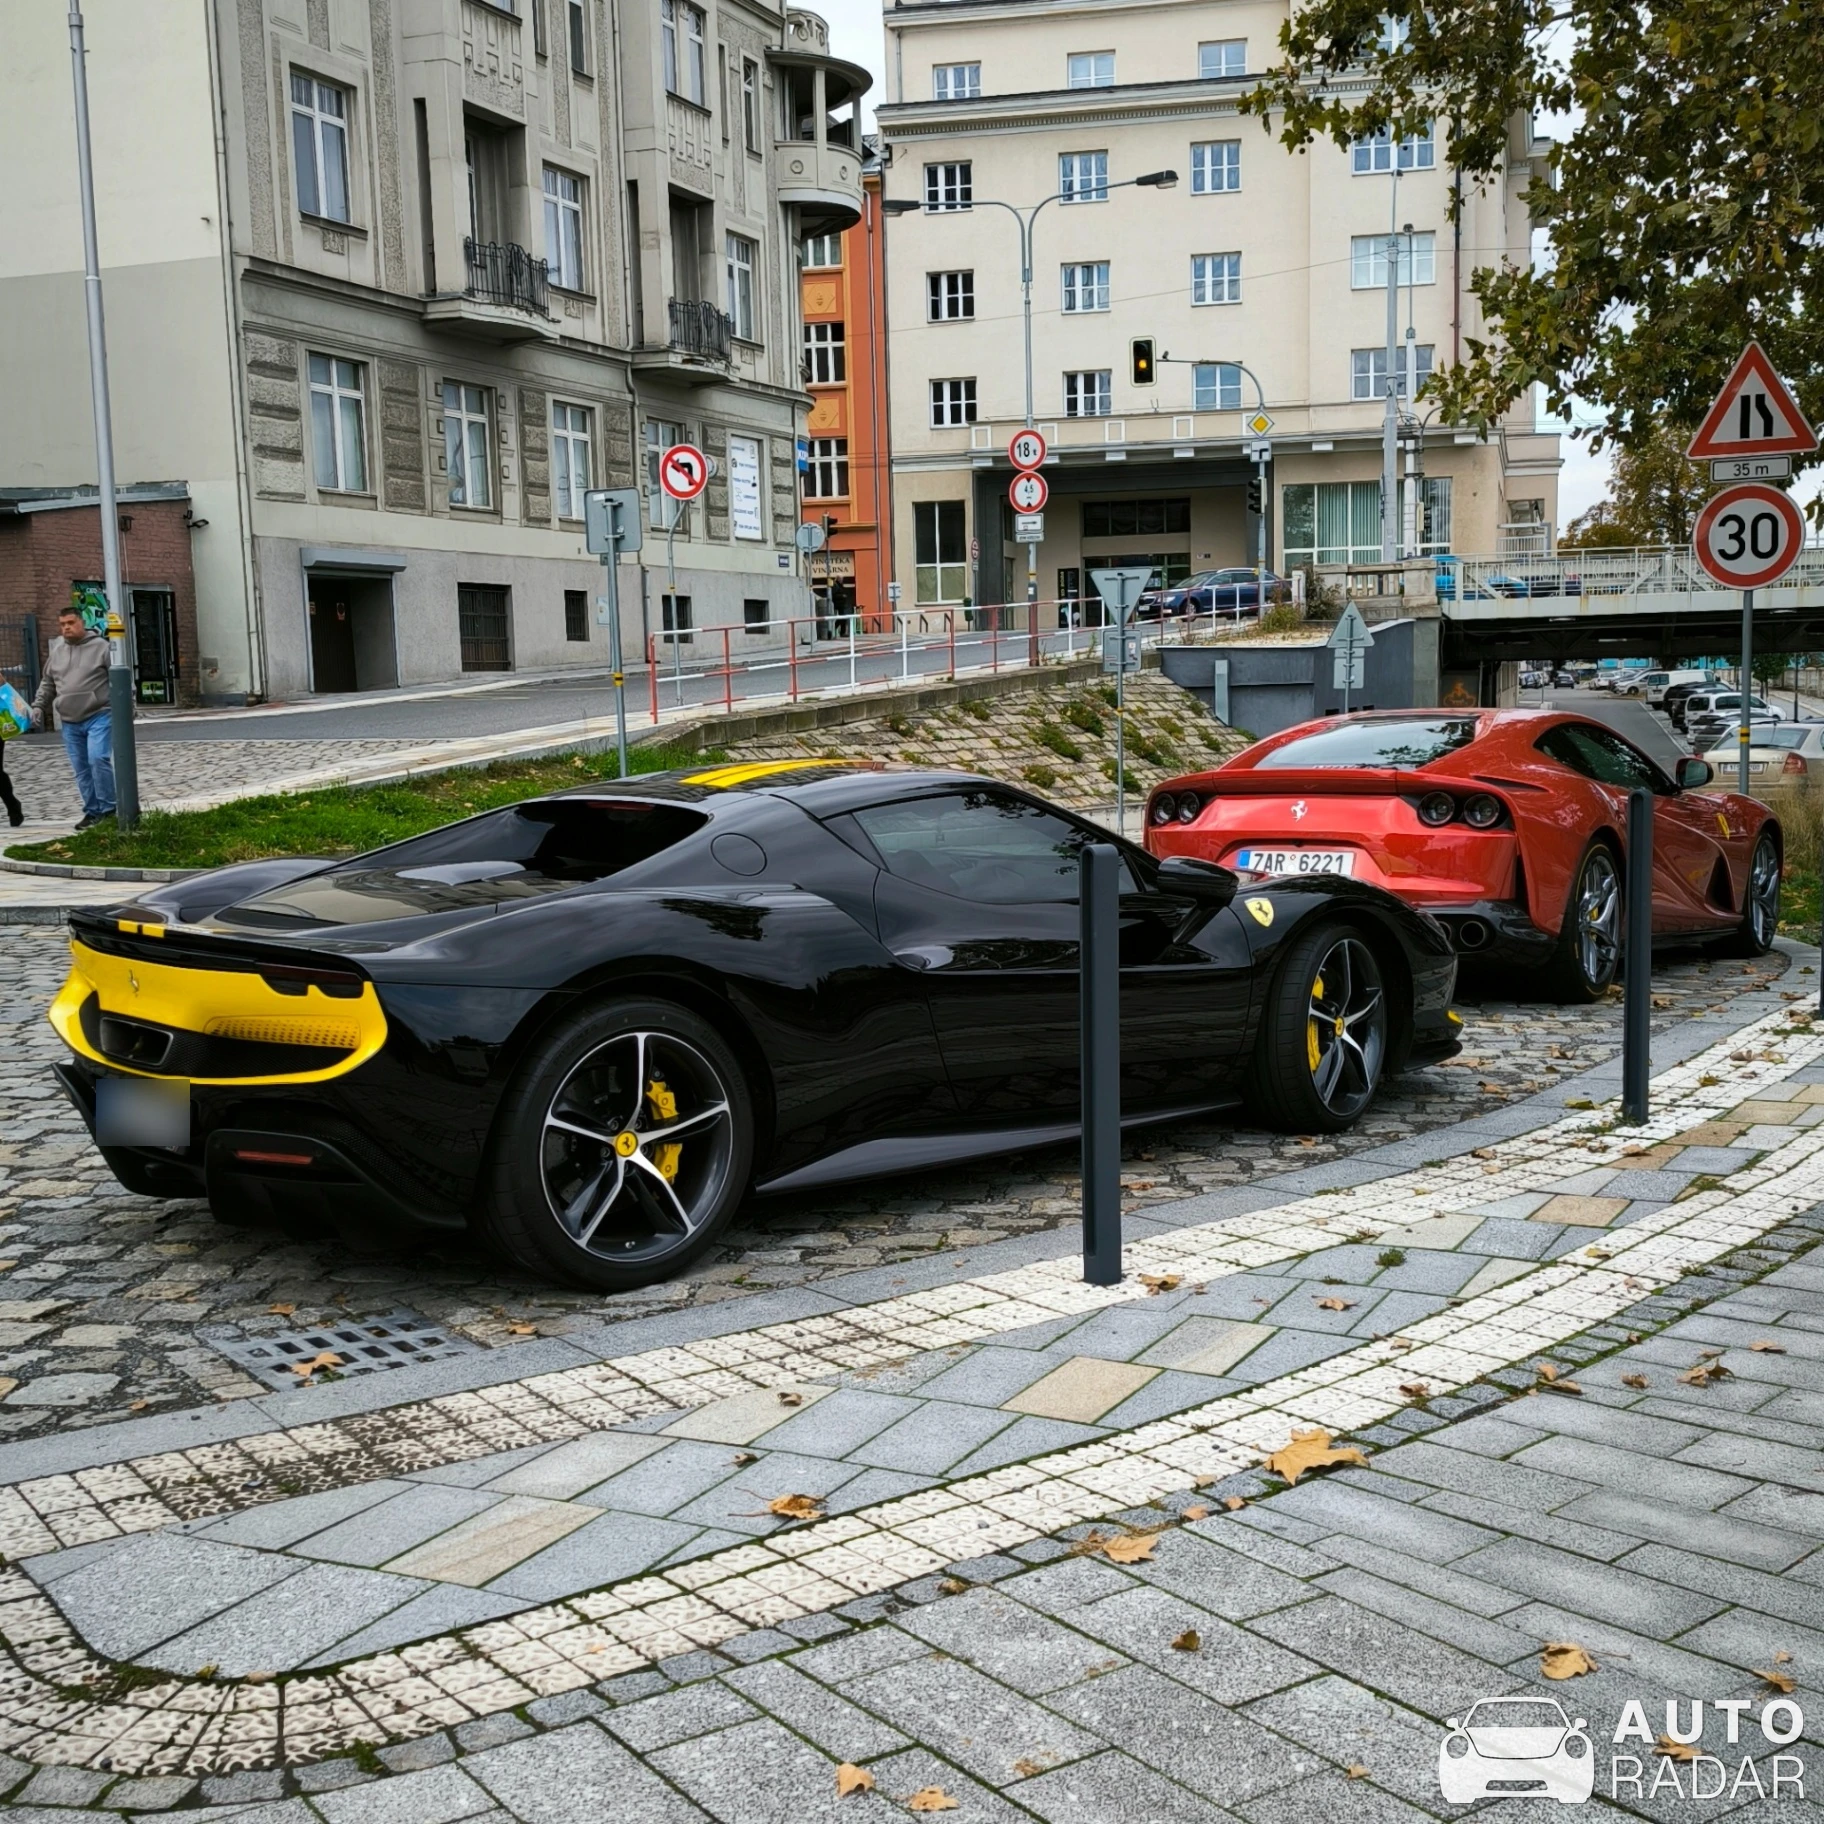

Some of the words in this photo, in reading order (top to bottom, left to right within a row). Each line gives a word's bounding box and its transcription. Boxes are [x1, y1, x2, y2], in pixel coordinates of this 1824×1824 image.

[1016, 441, 1030, 458] 18
[1733, 463, 1750, 477] 35
[1755, 463, 1769, 476] m
[1717, 512, 1779, 561] 30
[811, 556, 850, 565] VINTÉKA
[1253, 853, 1285, 872] 7AR
[1299, 854, 1344, 873] 6221
